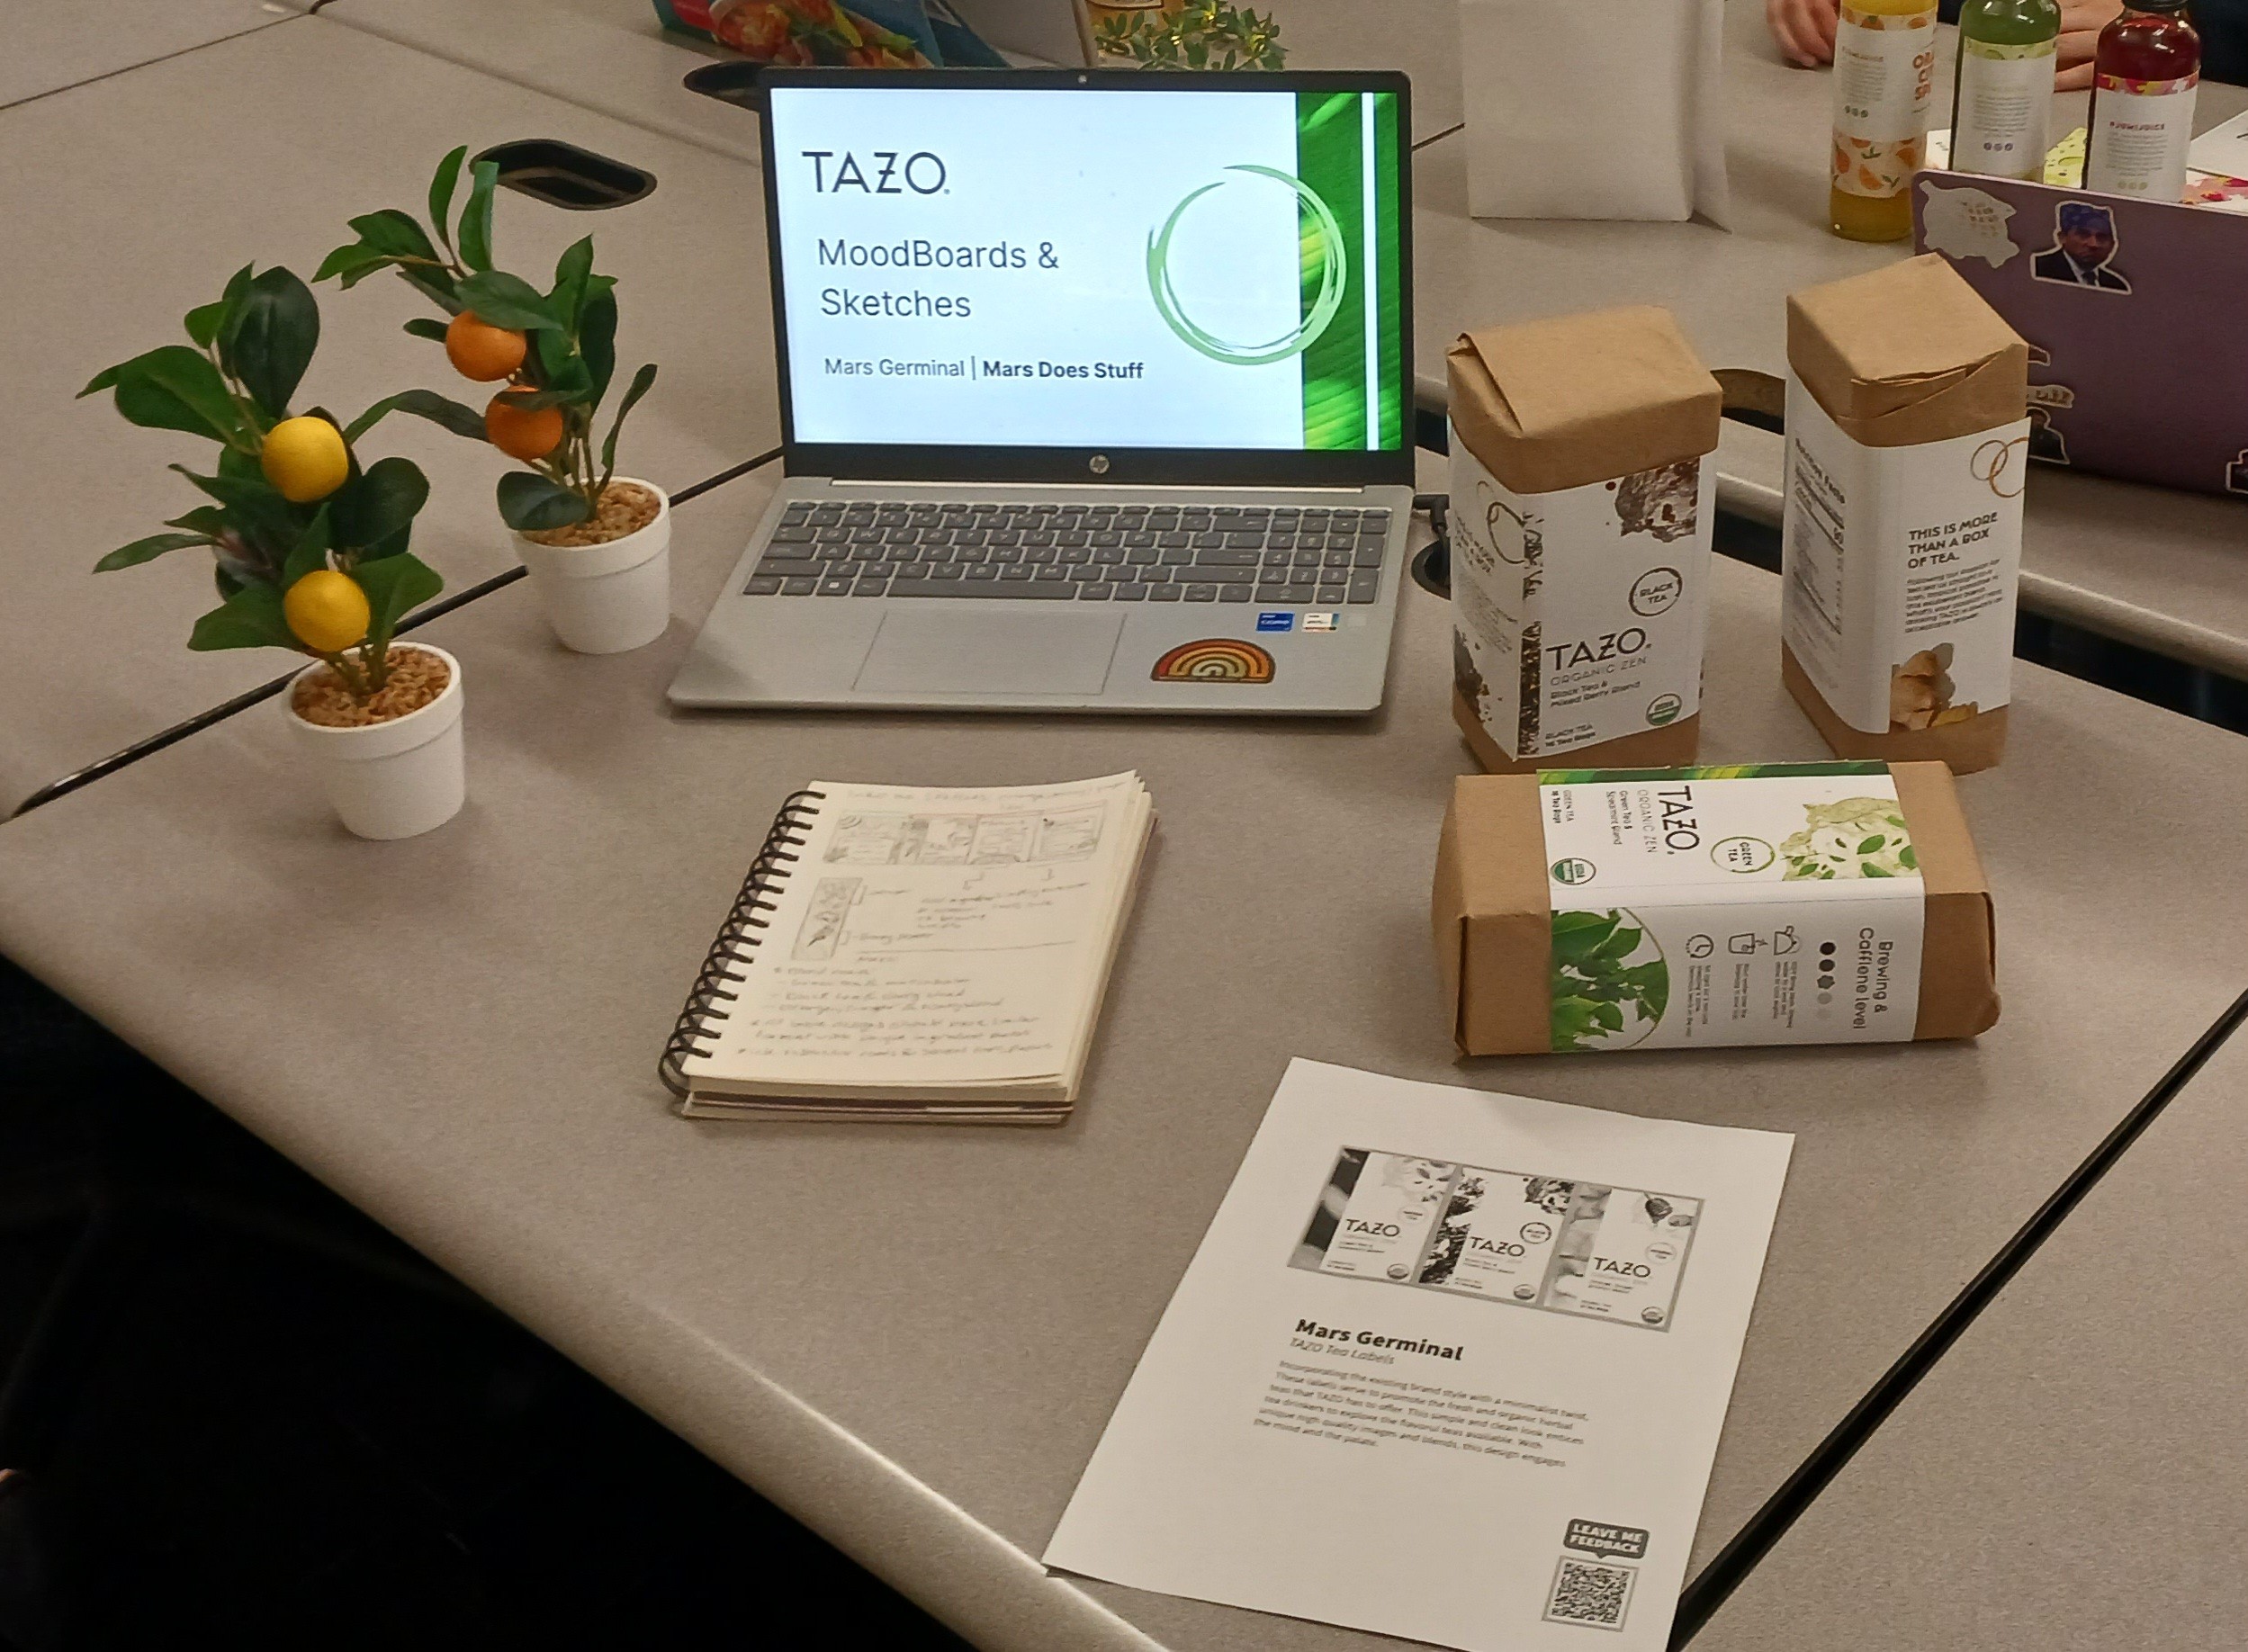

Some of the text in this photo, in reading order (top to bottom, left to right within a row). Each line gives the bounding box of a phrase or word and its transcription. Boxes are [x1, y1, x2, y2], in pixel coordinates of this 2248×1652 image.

[817, 238, 1059, 269] MoodBoards &
[820, 288, 972, 318] Sketches
[824, 358, 874, 377] Mars
[878, 359, 966, 378] Germinal
[983, 360, 1033, 378] Mars
[1038, 361, 1090, 379] Does
[1093, 360, 1145, 380] Stuff
[1909, 511, 1998, 541] THIS IS MORE
[1908, 527, 1990, 554] THAN A BOX
[1908, 556, 1927, 569] OF
[1872, 940, 1893, 1013] Brewing &
[1852, 996, 1870, 1029] level
[1345, 1218, 1400, 1237] TAZO
[1470, 1236, 1525, 1257] TAZO
[1594, 1256, 1651, 1278] TAZO
[1290, 1337, 1395, 1365] TAZO Tea Labels
[1295, 1319, 1464, 1360] Mars Germinal
[1569, 1534, 1641, 1553] FEEDBACK
[1572, 1523, 1643, 1543] LEAVE ME
